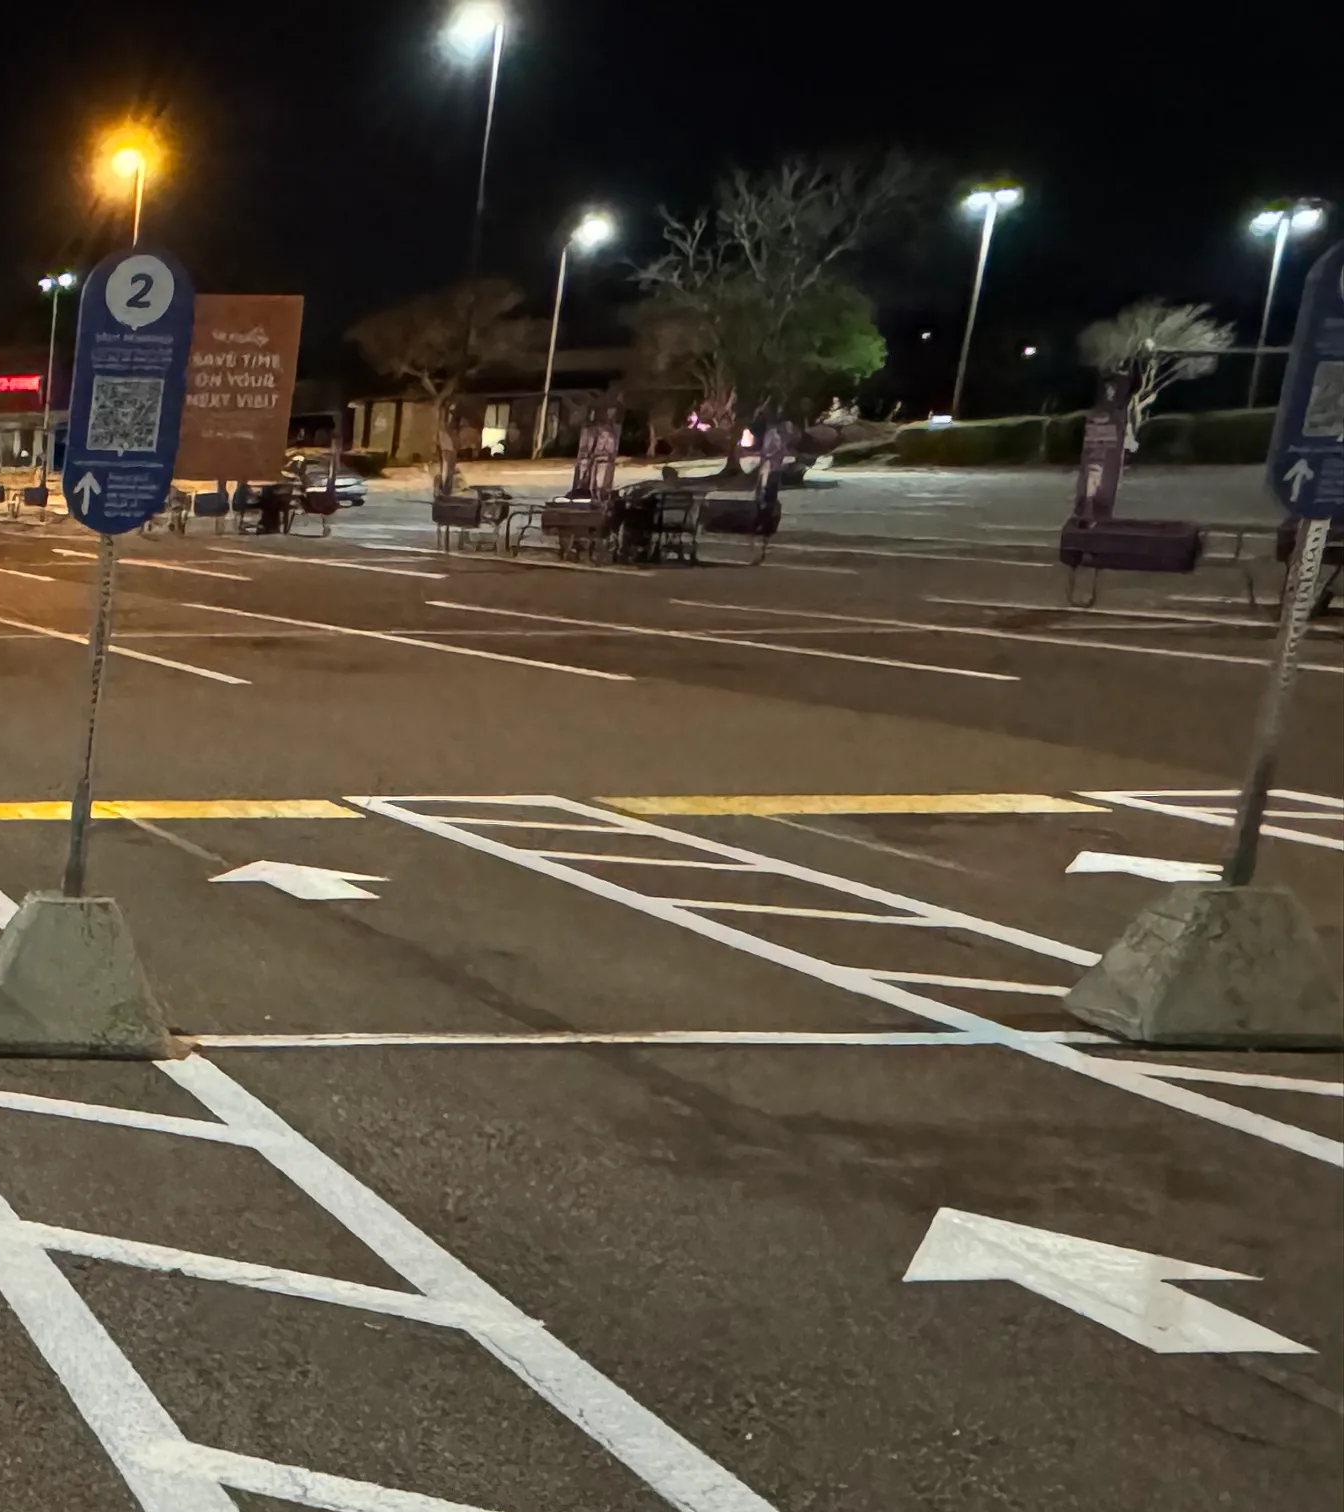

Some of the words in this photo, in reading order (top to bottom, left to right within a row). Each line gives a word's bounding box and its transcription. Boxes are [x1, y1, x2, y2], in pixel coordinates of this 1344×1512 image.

[126, 273, 154, 308] 2
[241, 354, 281, 369] TIME
[227, 372, 276, 388] YOUR
